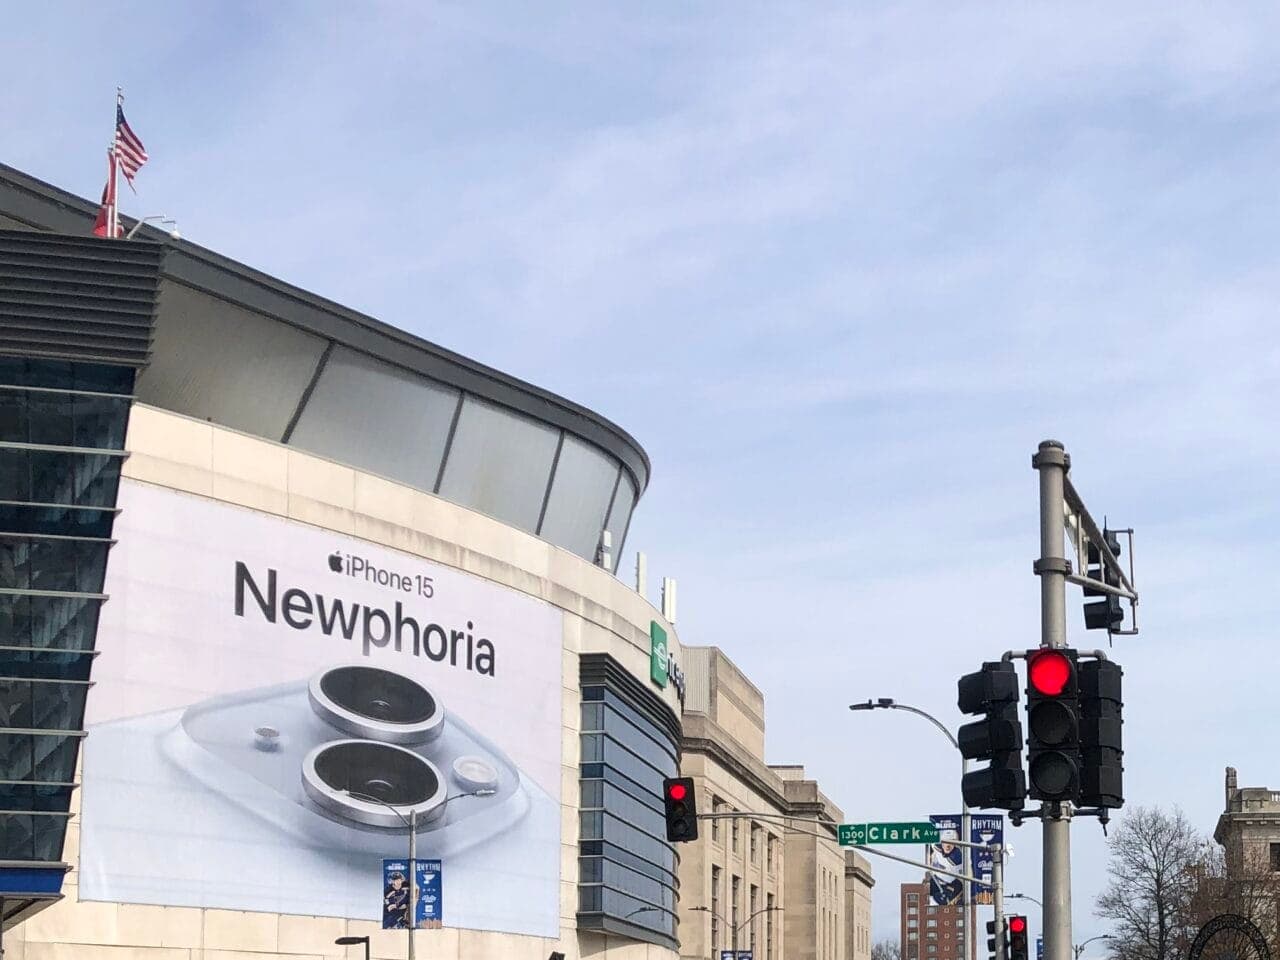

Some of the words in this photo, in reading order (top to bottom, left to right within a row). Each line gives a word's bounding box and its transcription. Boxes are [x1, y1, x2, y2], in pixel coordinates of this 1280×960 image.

[346, 554, 412, 592] iPhone
[415, 575, 434, 599] 15
[234, 560, 496, 677] Newphoria
[841, 831, 864, 839] 1300
[869, 827, 920, 840] Clark
[972, 819, 1002, 830] RHYTHM
